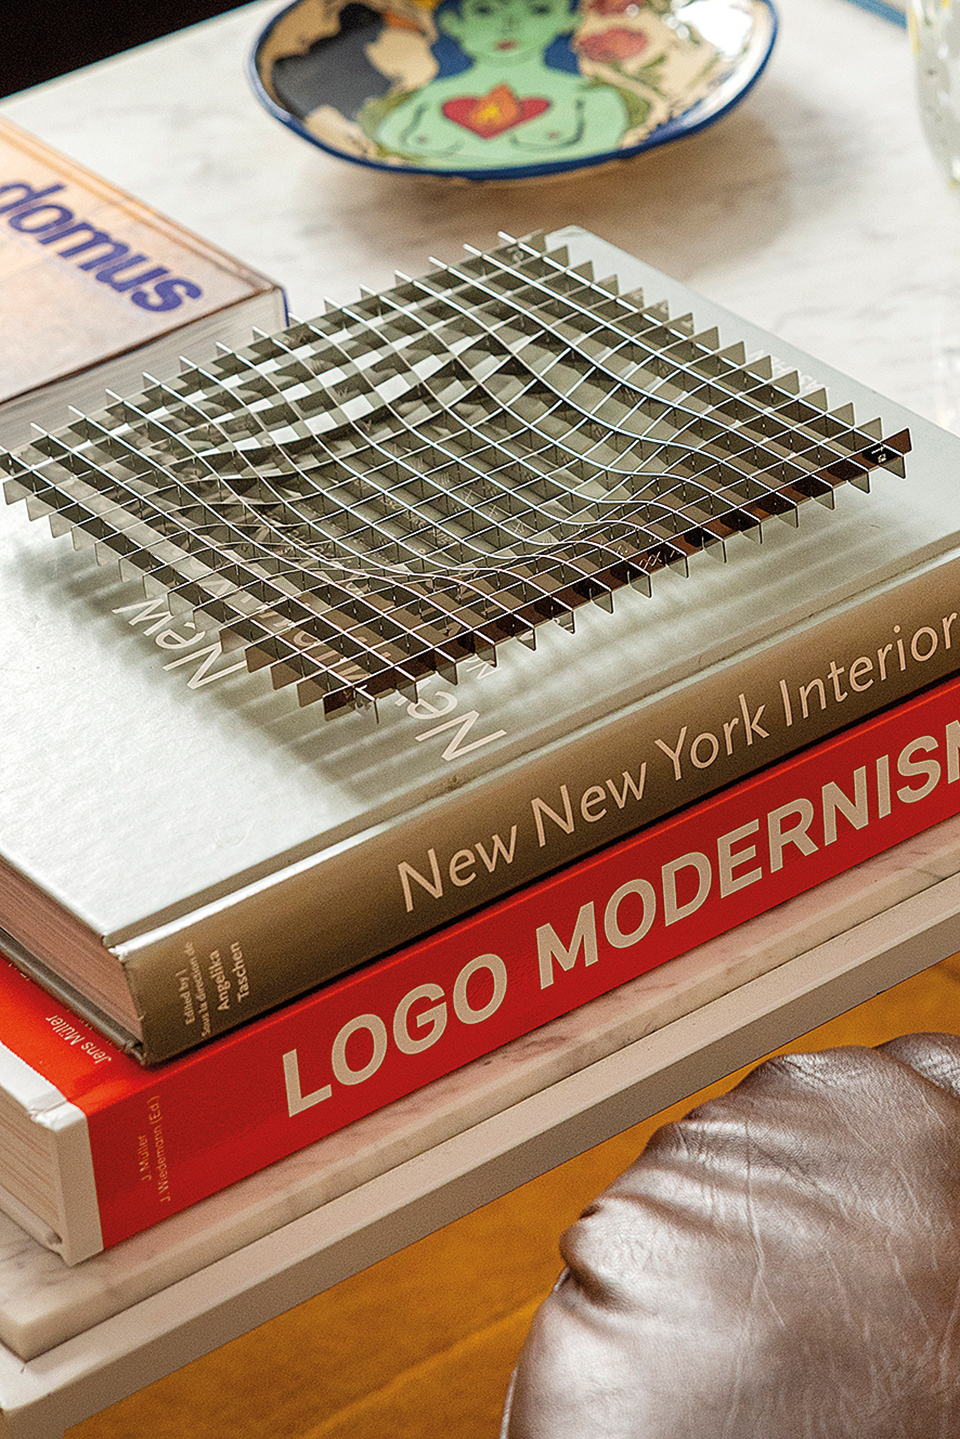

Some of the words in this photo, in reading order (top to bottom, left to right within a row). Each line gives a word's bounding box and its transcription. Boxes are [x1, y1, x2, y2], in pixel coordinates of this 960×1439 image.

[0, 182, 202, 312] domus
[398, 825, 517, 912] New
[531, 761, 647, 847] New
[655, 693, 770, 780] York
[208, 949, 231, 1010] Angelika
[230, 941, 250, 1003] Taschen
[45, 1015, 85, 1046] Müller
[179, 990, 196, 1026] Edited
[282, 953, 507, 1117] LOGO
[81, 1041, 112, 1064] Jens
[154, 1124, 169, 1194] Wiedemann
